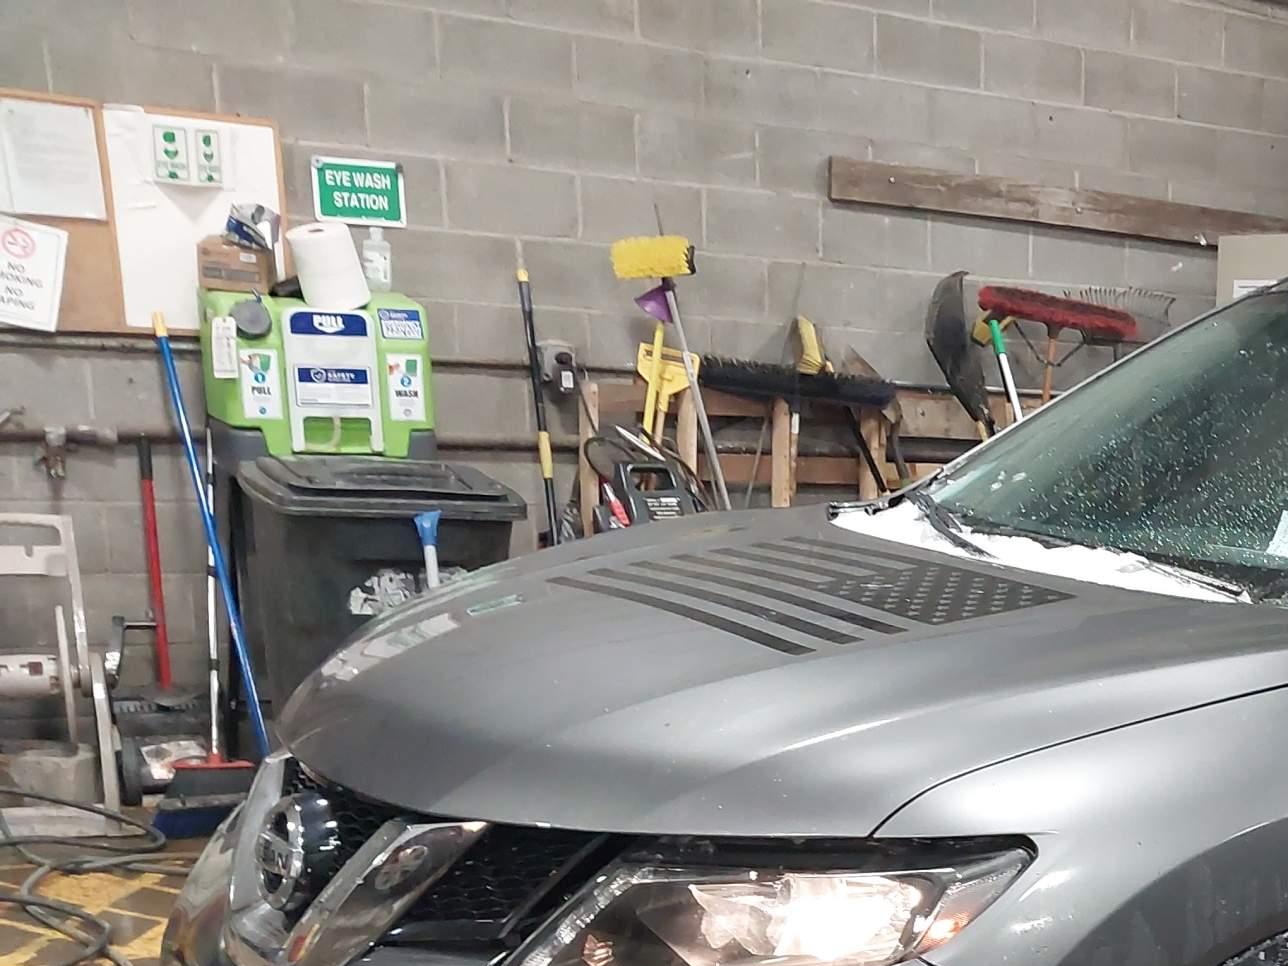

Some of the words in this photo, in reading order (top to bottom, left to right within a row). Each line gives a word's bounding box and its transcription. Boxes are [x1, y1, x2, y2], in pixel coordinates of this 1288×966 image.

[325, 169, 351, 187] EYE
[352, 172, 391, 190] WASH
[333, 191, 389, 210] STATION
[7, 261, 25, 273] NO
[6, 285, 24, 297] NO
[251, 386, 271, 395] PULL
[394, 390, 418, 398] WASH
